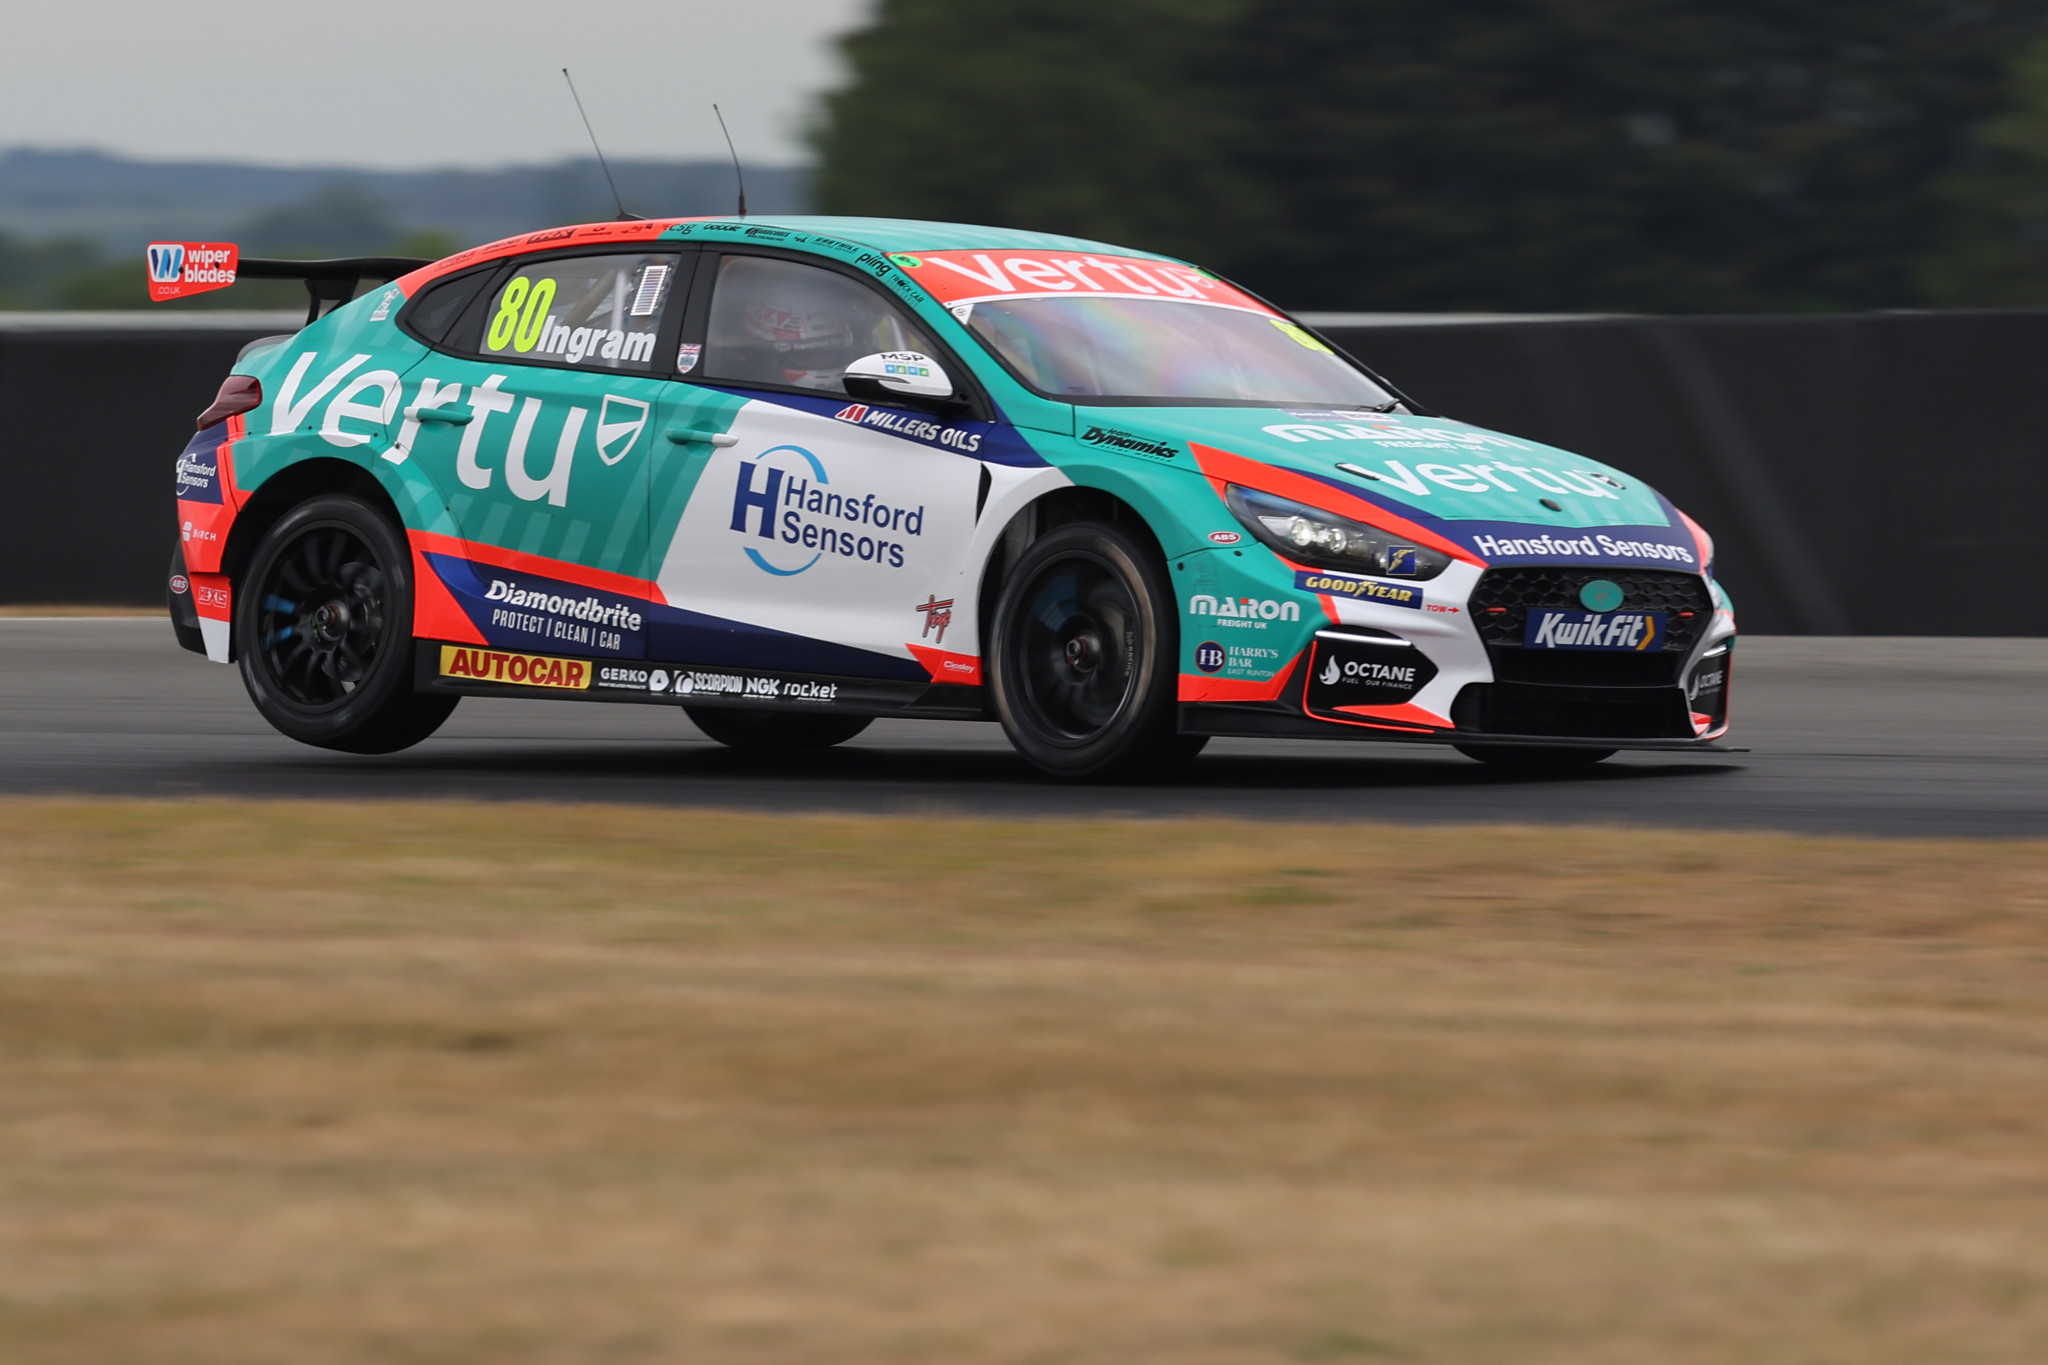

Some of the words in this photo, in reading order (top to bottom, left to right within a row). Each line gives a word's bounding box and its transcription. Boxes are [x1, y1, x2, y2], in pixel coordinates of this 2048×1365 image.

[187, 244, 231, 269] wiper
[184, 263, 236, 283] blades
[925, 253, 1210, 301] Vertu
[487, 276, 557, 353] 80
[536, 315, 656, 364] Ingram
[880, 353, 925, 361] MSP
[265, 351, 588, 508] Vertu
[864, 410, 941, 441] MILLERS
[940, 428, 981, 452] OILS
[1081, 427, 1179, 458] Dynamics
[184, 461, 217, 477] Hansford
[181, 472, 209, 488] Sensors
[730, 460, 785, 540] H
[784, 475, 924, 537] Hansford
[192, 529, 217, 541] BIRCH
[781, 510, 905, 568] Sensors
[1213, 533, 1237, 541] ABS
[1473, 534, 1595, 557] Hansford
[1594, 534, 1695, 563] Sensors
[171, 579, 186, 590] ABS
[484, 580, 642, 631] Diamondbrite
[1426, 604, 1447, 613] TOW
[492, 608, 545, 634] PROTECT
[553, 621, 589, 645] CLEAN
[599, 631, 621, 650] CAR
[1217, 618, 1253, 629] FREIGHT
[1254, 621, 1268, 629] UK
[1199, 649, 1224, 667] HB
[1228, 657, 1253, 668] BAR
[1229, 646, 1279, 659] HARRY'S
[448, 648, 585, 688] AUTOCAR
[600, 667, 648, 683] GERKO
[1227, 668, 1245, 676] EAST
[1343, 661, 1417, 683] OCTANE
[694, 672, 743, 693] SCORPION
[745, 677, 780, 696] NGK
[783, 681, 838, 698] rocket
[1342, 676, 1359, 685] FUEL
[1381, 681, 1414, 690] FINANCE
